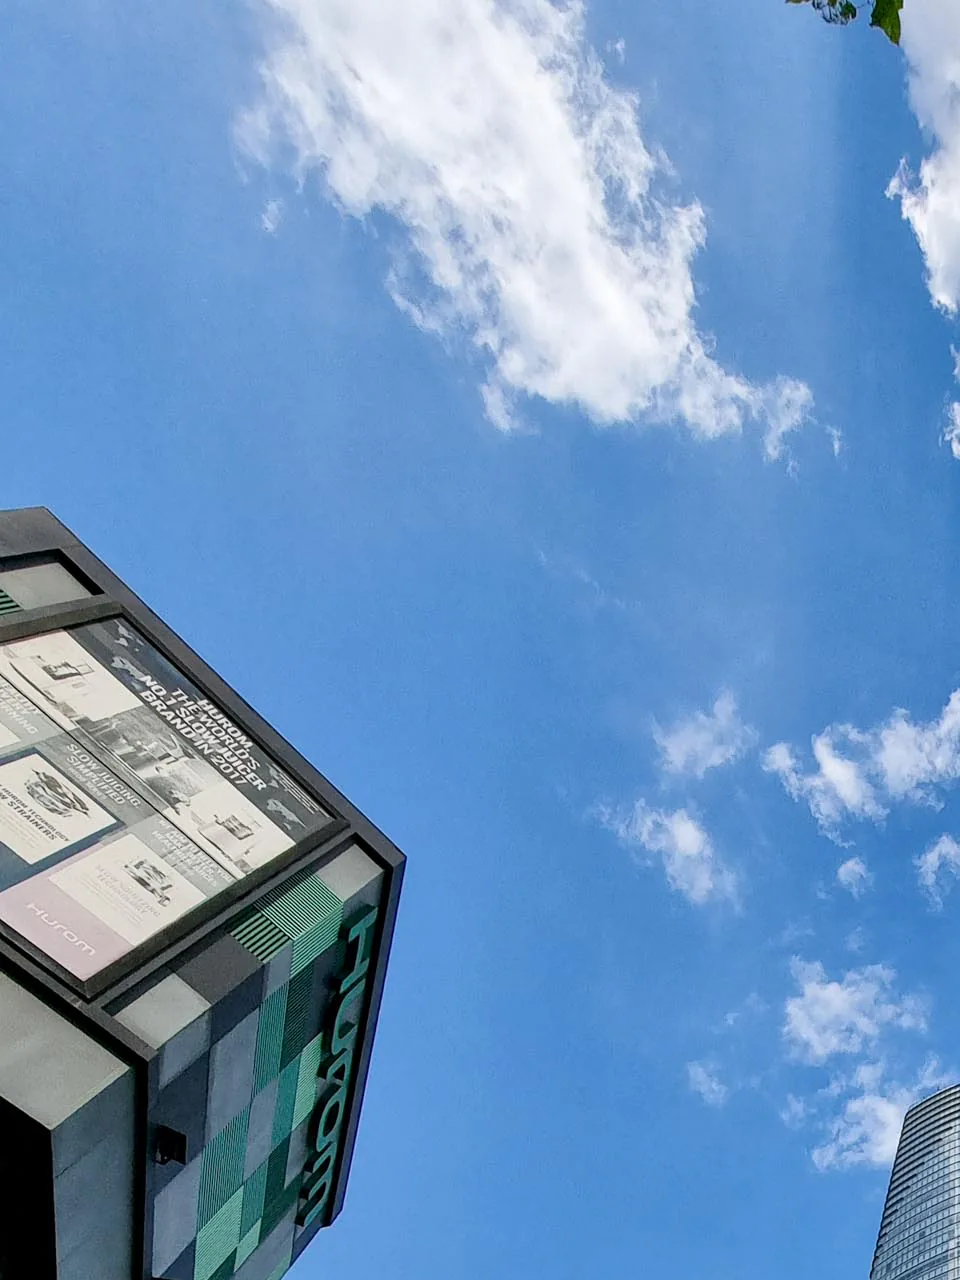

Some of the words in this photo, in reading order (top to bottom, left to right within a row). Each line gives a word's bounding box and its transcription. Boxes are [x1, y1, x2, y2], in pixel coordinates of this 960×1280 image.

[67, 744, 99, 773] SLOW
[140, 675, 177, 705] NO.1
[176, 708, 220, 745] SLOW
[217, 746, 267, 791] JUICER
[140, 691, 197, 738] BRAND
[193, 738, 214, 755] IN
[210, 755, 248, 784] 2017
[172, 688, 201, 713] THE
[199, 714, 260, 770] WORLD'S
[67, 756, 126, 805] SIMPLIFIED
[8, 801, 57, 842] STRAINERS
